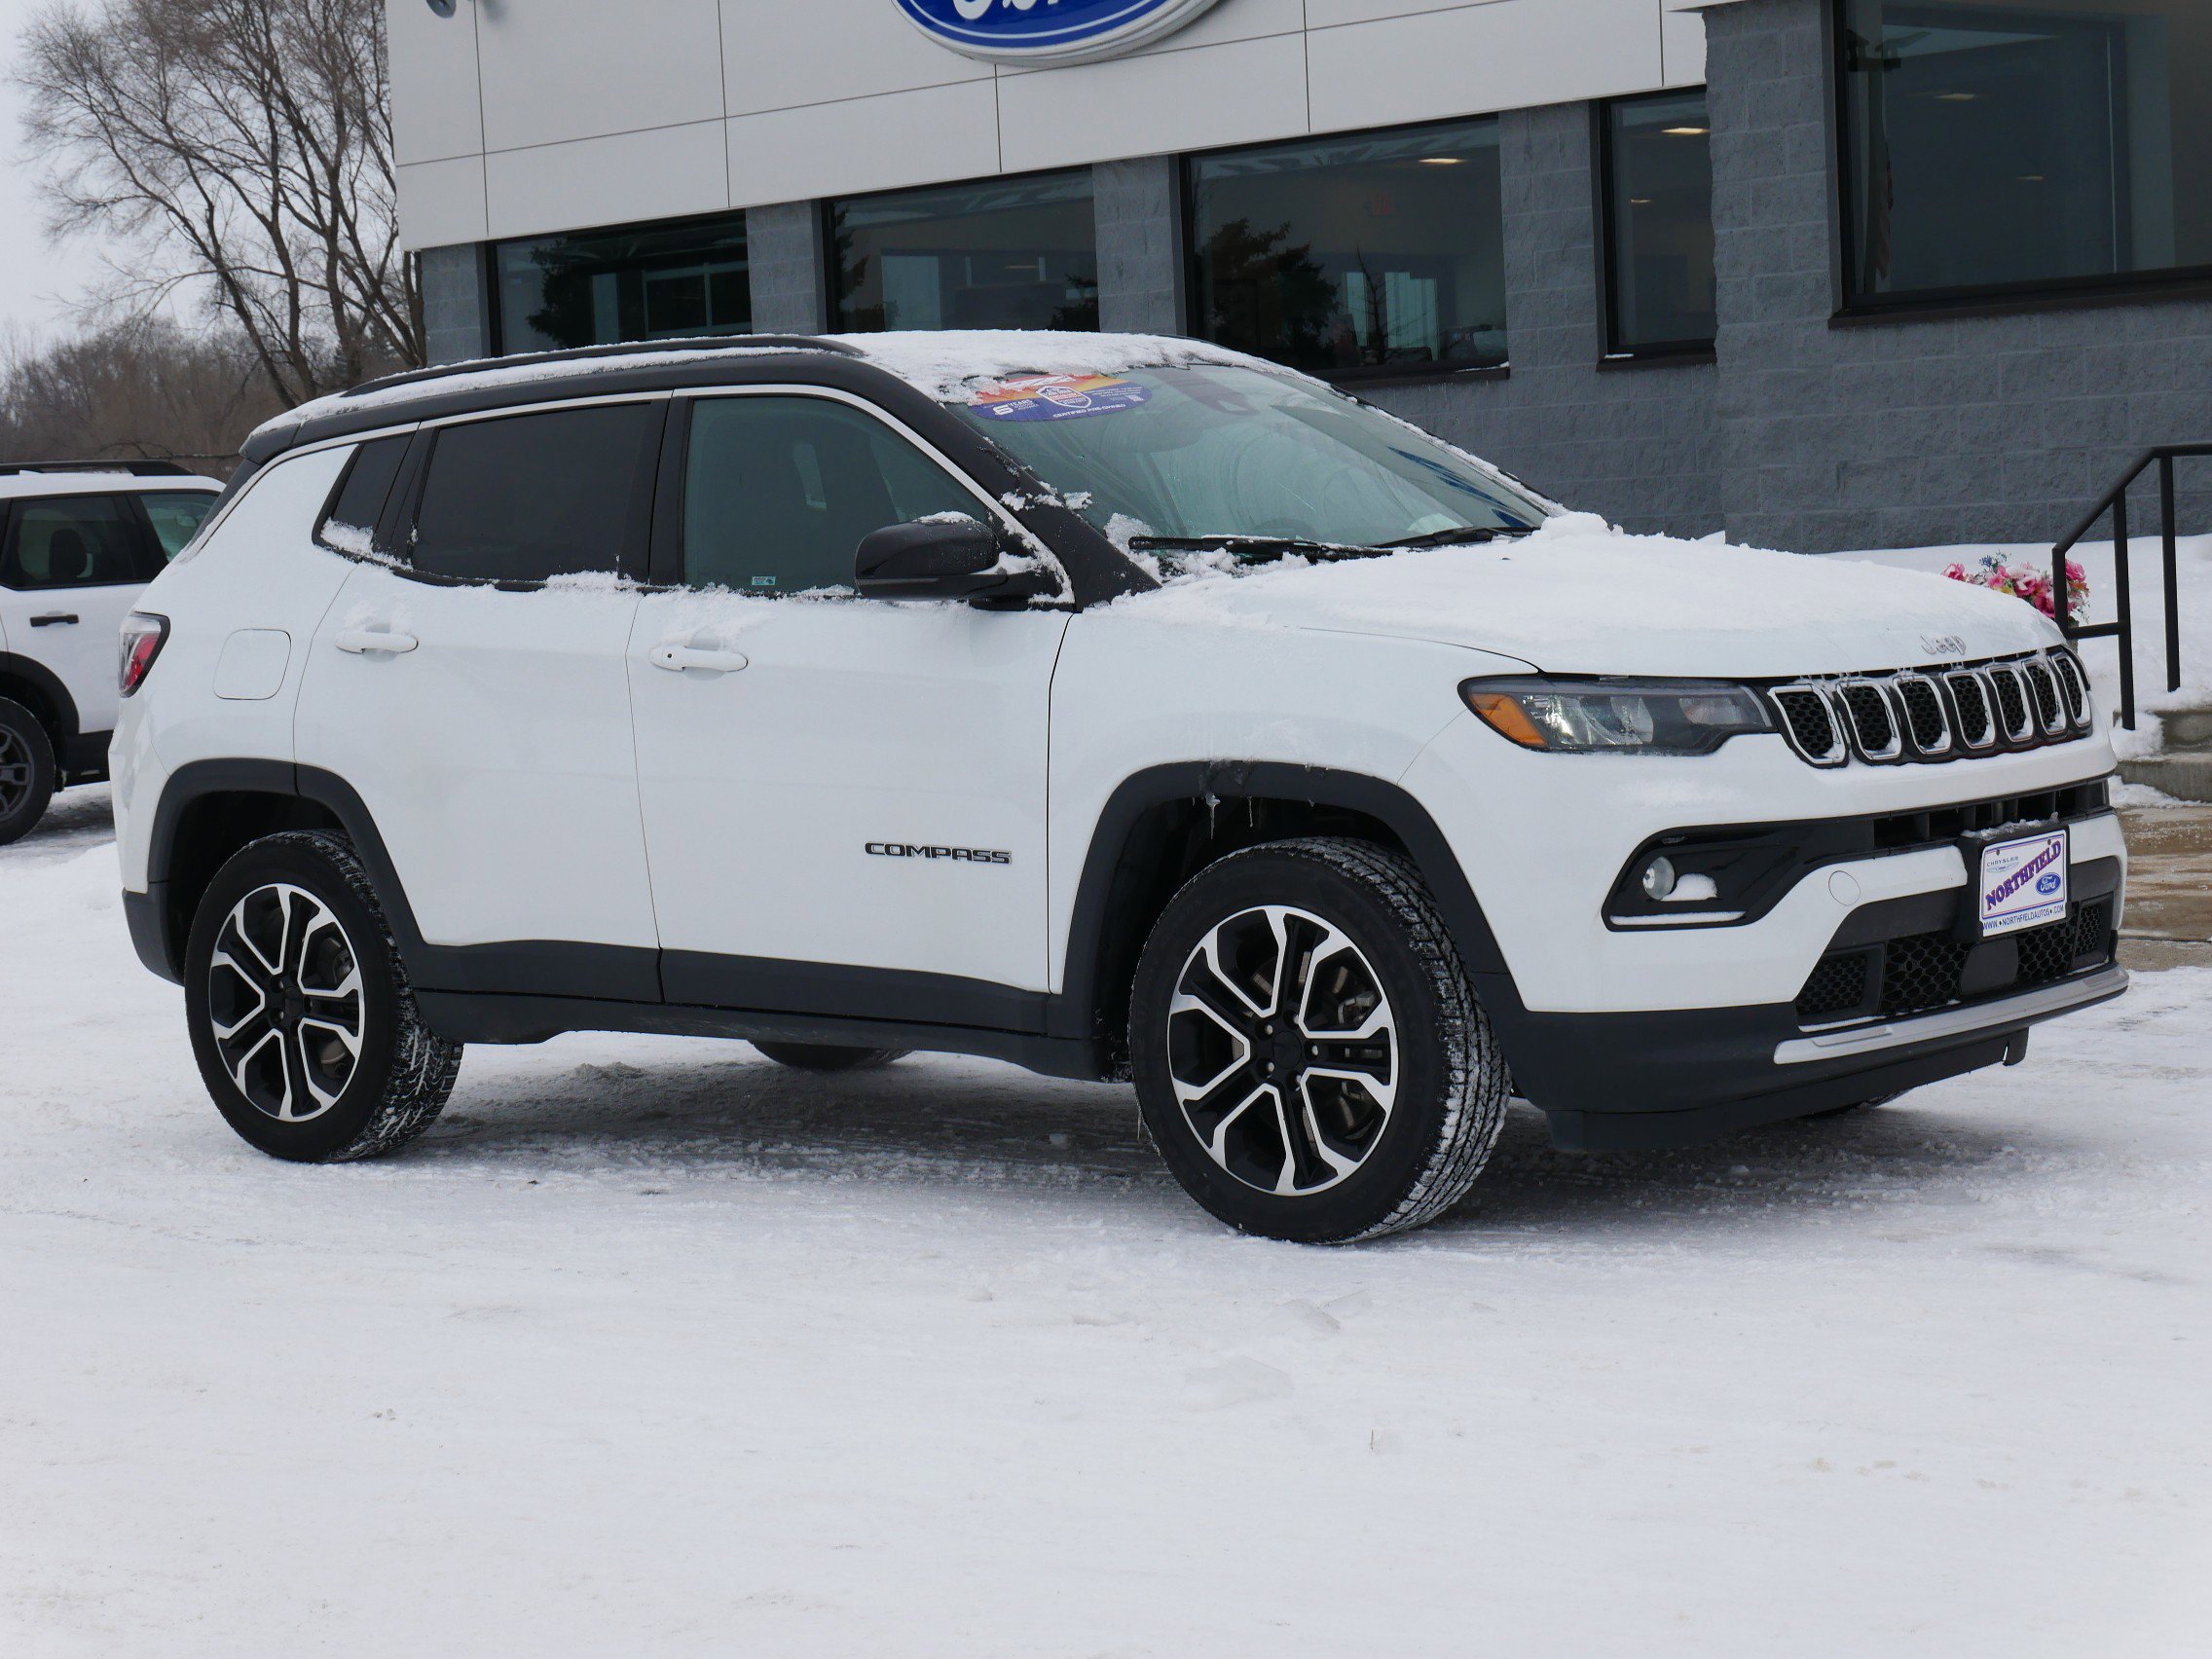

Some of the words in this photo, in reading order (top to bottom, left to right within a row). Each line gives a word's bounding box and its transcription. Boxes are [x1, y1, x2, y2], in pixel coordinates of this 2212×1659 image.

[1920, 634, 1967, 655] Jeep
[865, 841, 1014, 865] COMPASS
[1986, 856, 2019, 866] CHRYSLER
[1985, 840, 2061, 910] NORTHFIELD
[2040, 875, 2057, 892] Ford
